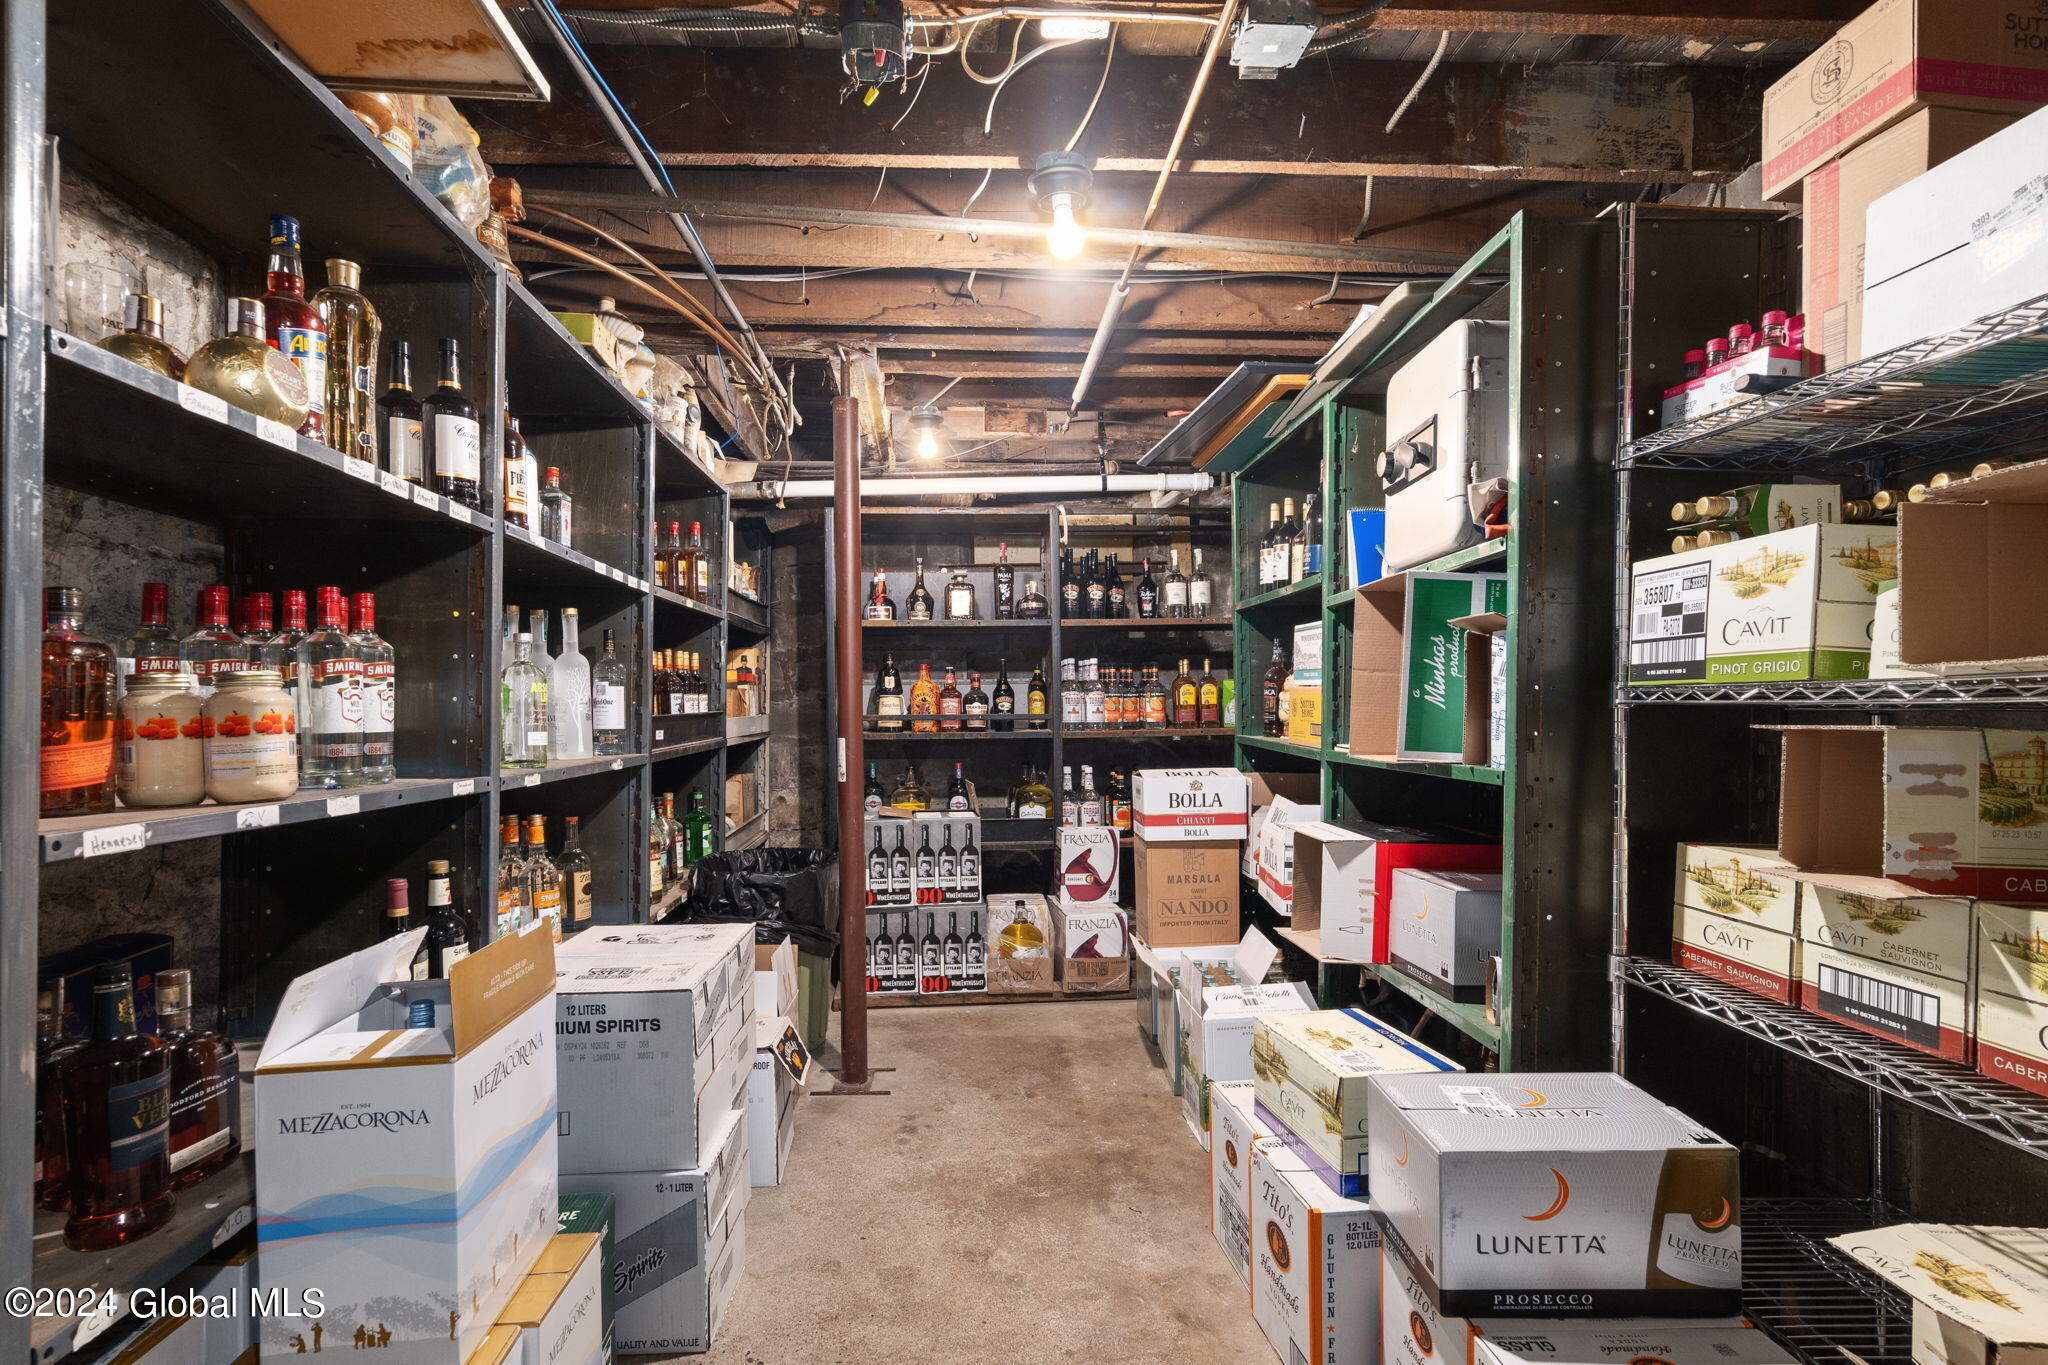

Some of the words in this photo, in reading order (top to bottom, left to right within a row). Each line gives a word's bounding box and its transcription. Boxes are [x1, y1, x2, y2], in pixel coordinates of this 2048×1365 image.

[1767, 151, 1810, 182] WHITE
[1816, 88, 1905, 150] ZINFANDEL
[1644, 584, 1674, 605] 355807
[1722, 616, 1792, 649] CAVIT
[1423, 634, 1446, 710] Minhas
[1711, 661, 1748, 677] PINOT
[1753, 659, 1801, 675] GRIGIO
[1165, 770, 1219, 778] BOLLA
[1169, 792, 1223, 809] BOLLA
[1176, 815, 1216, 825] CHIANTI
[1064, 834, 1110, 847] FRANZIA
[1184, 828, 1210, 837] BOLLA
[1167, 874, 1221, 885] MARSALA
[916, 888, 943, 904] 90
[1159, 899, 1229, 917] NANDO
[1069, 919, 1117, 932] FRANZIA
[1160, 920, 1191, 928] IMPORTED
[1193, 920, 1210, 928] FROM
[1211, 918, 1229, 927] ITALY
[1402, 919, 1438, 945] LUNETTA
[1703, 923, 1753, 953] CAVIT
[1818, 922, 1868, 949] CAVIT
[1882, 940, 1940, 962] CABERNET
[1680, 949, 1723, 972] CABERNET
[1726, 964, 1779, 992] SAUVIGNON
[1880, 950, 1942, 973] SAUVIGNON
[1407, 964, 1433, 983] PROSECCO
[922, 976, 948, 992] 90
[565, 1005, 576, 1017] 12
[578, 1004, 606, 1017] LITERS
[596, 1017, 661, 1034] SPIRITS
[472, 1031, 544, 1105] MEZZACORONA
[206, 1075, 236, 1094] RESERVE
[1280, 1089, 1306, 1120] CAVIT
[278, 1108, 431, 1135] MEZZACORONA
[1223, 1116, 1240, 1147] Tito's
[1277, 1124, 1307, 1160] MERLOT
[675, 1183, 693, 1192] LITER
[1262, 1179, 1295, 1230] Tito's
[1346, 1221, 1372, 1232] 12-1L
[1346, 1231, 1379, 1241] BOTTLES
[1346, 1241, 1361, 1251] 12.0
[1476, 1232, 1606, 1256] LUNETTA
[1667, 1232, 1740, 1263] LUNETTA
[1676, 1249, 1731, 1269] PROSECCO
[1851, 1246, 1917, 1280] CAVIT
[614, 1247, 666, 1295] Spirits
[1327, 1233, 1335, 1319] GLUTEN
[1260, 1252, 1299, 1315] Handmade
[1406, 1275, 1438, 1323] Tito's
[1494, 1293, 1593, 1306] PROSECCO
[1928, 1293, 1985, 1325] MERLOT
[649, 1337, 668, 1349] AND
[670, 1336, 700, 1348] VALUE
[1497, 1340, 1557, 1353] GLASS
